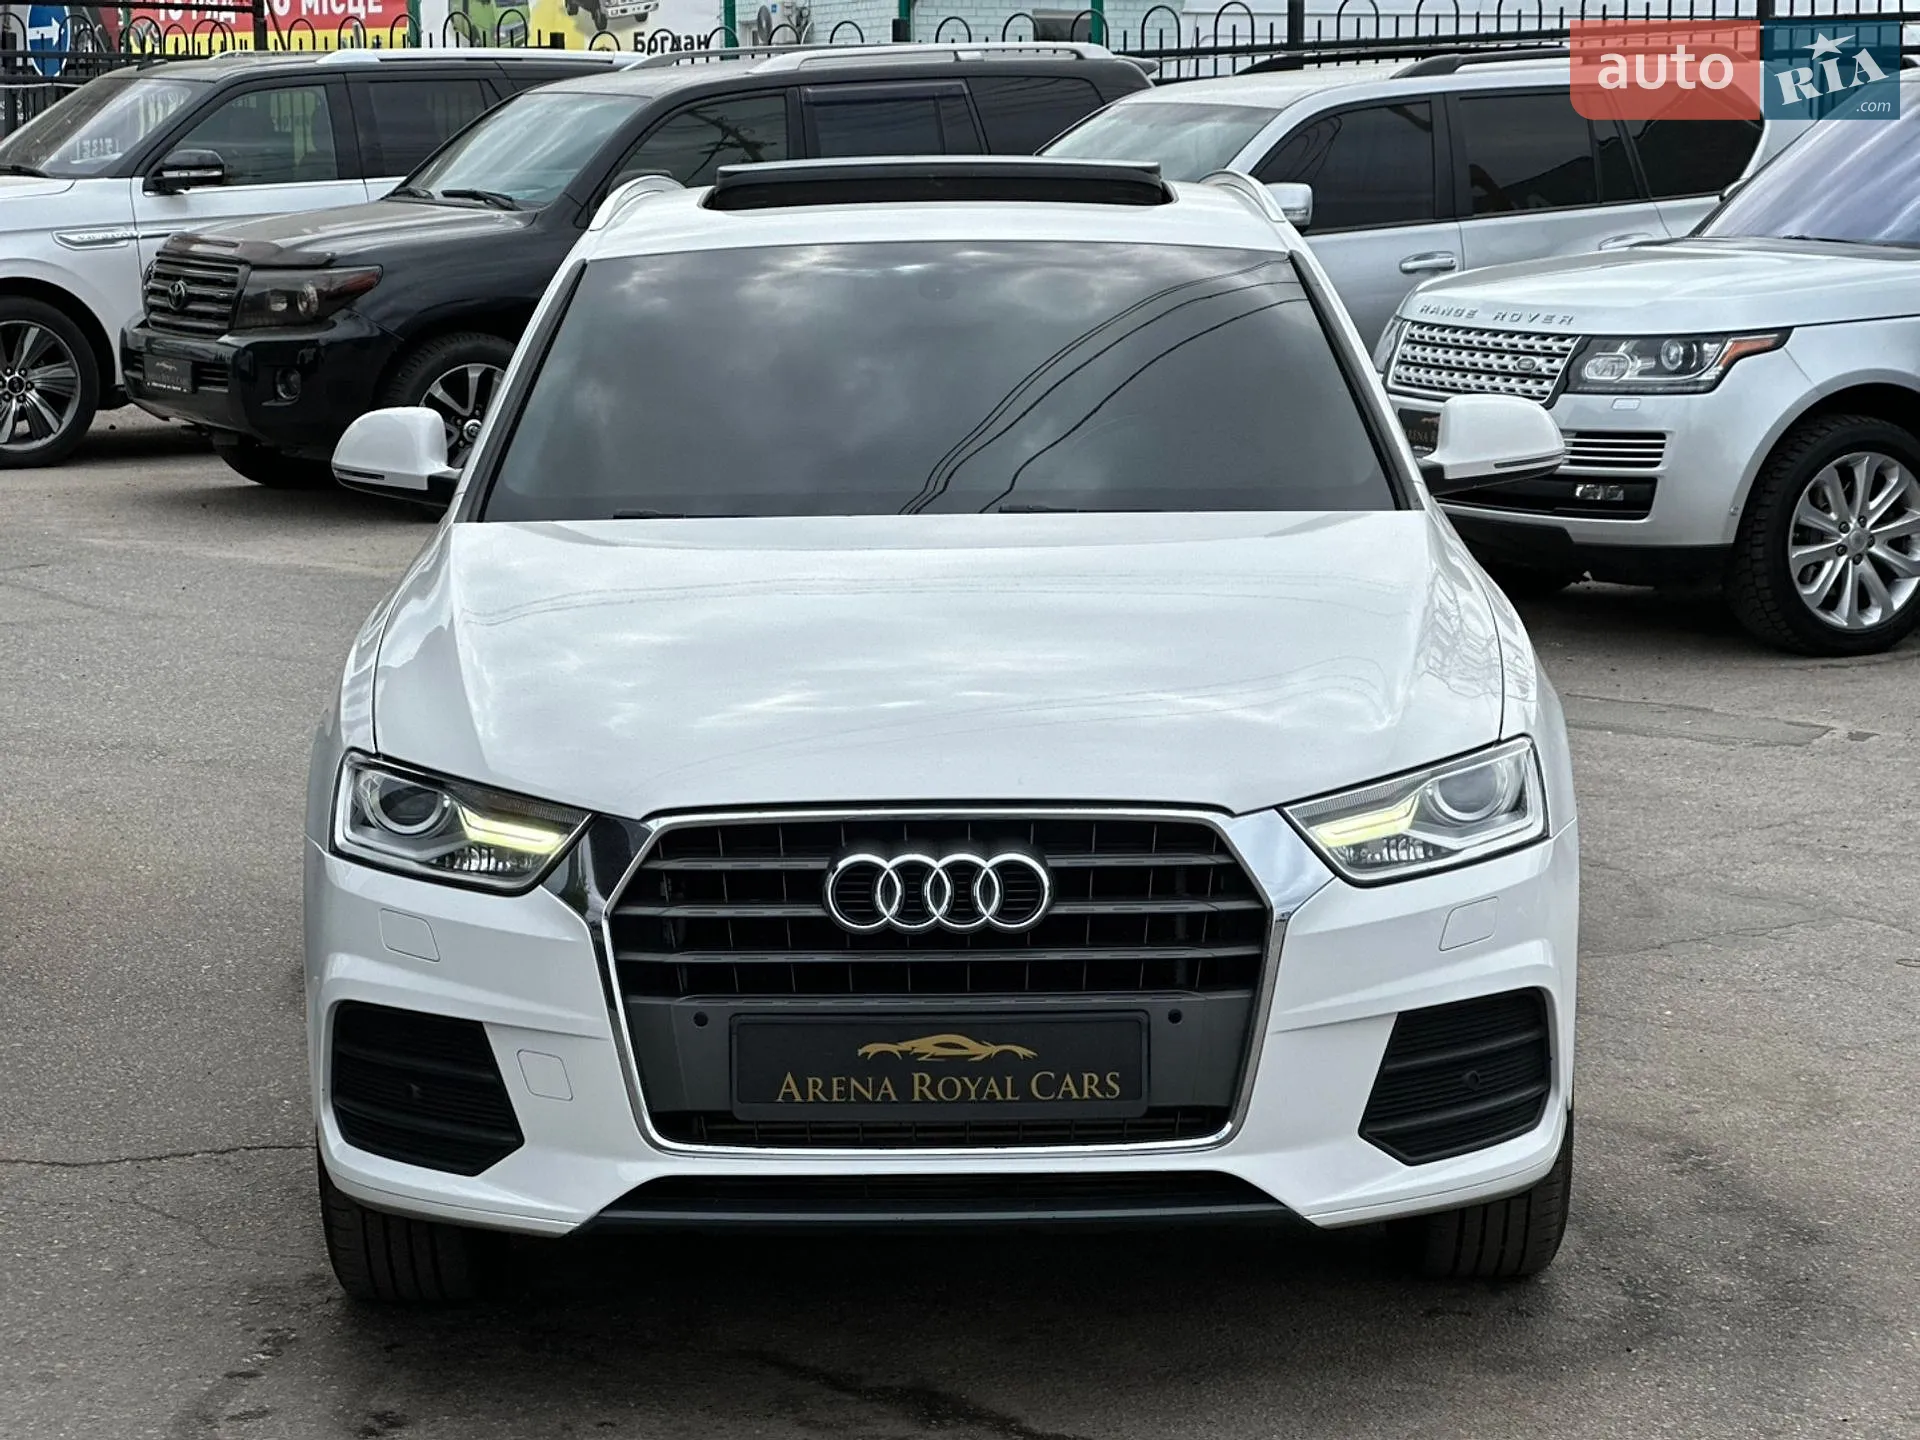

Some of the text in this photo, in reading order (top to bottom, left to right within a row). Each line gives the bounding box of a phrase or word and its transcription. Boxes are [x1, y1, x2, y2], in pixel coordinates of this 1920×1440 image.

[633, 31, 709, 54] Богдан
[1419, 304, 1575, 326] RANGE ROVER
[776, 1071, 1121, 1102] ARENA ROYAL CARS
